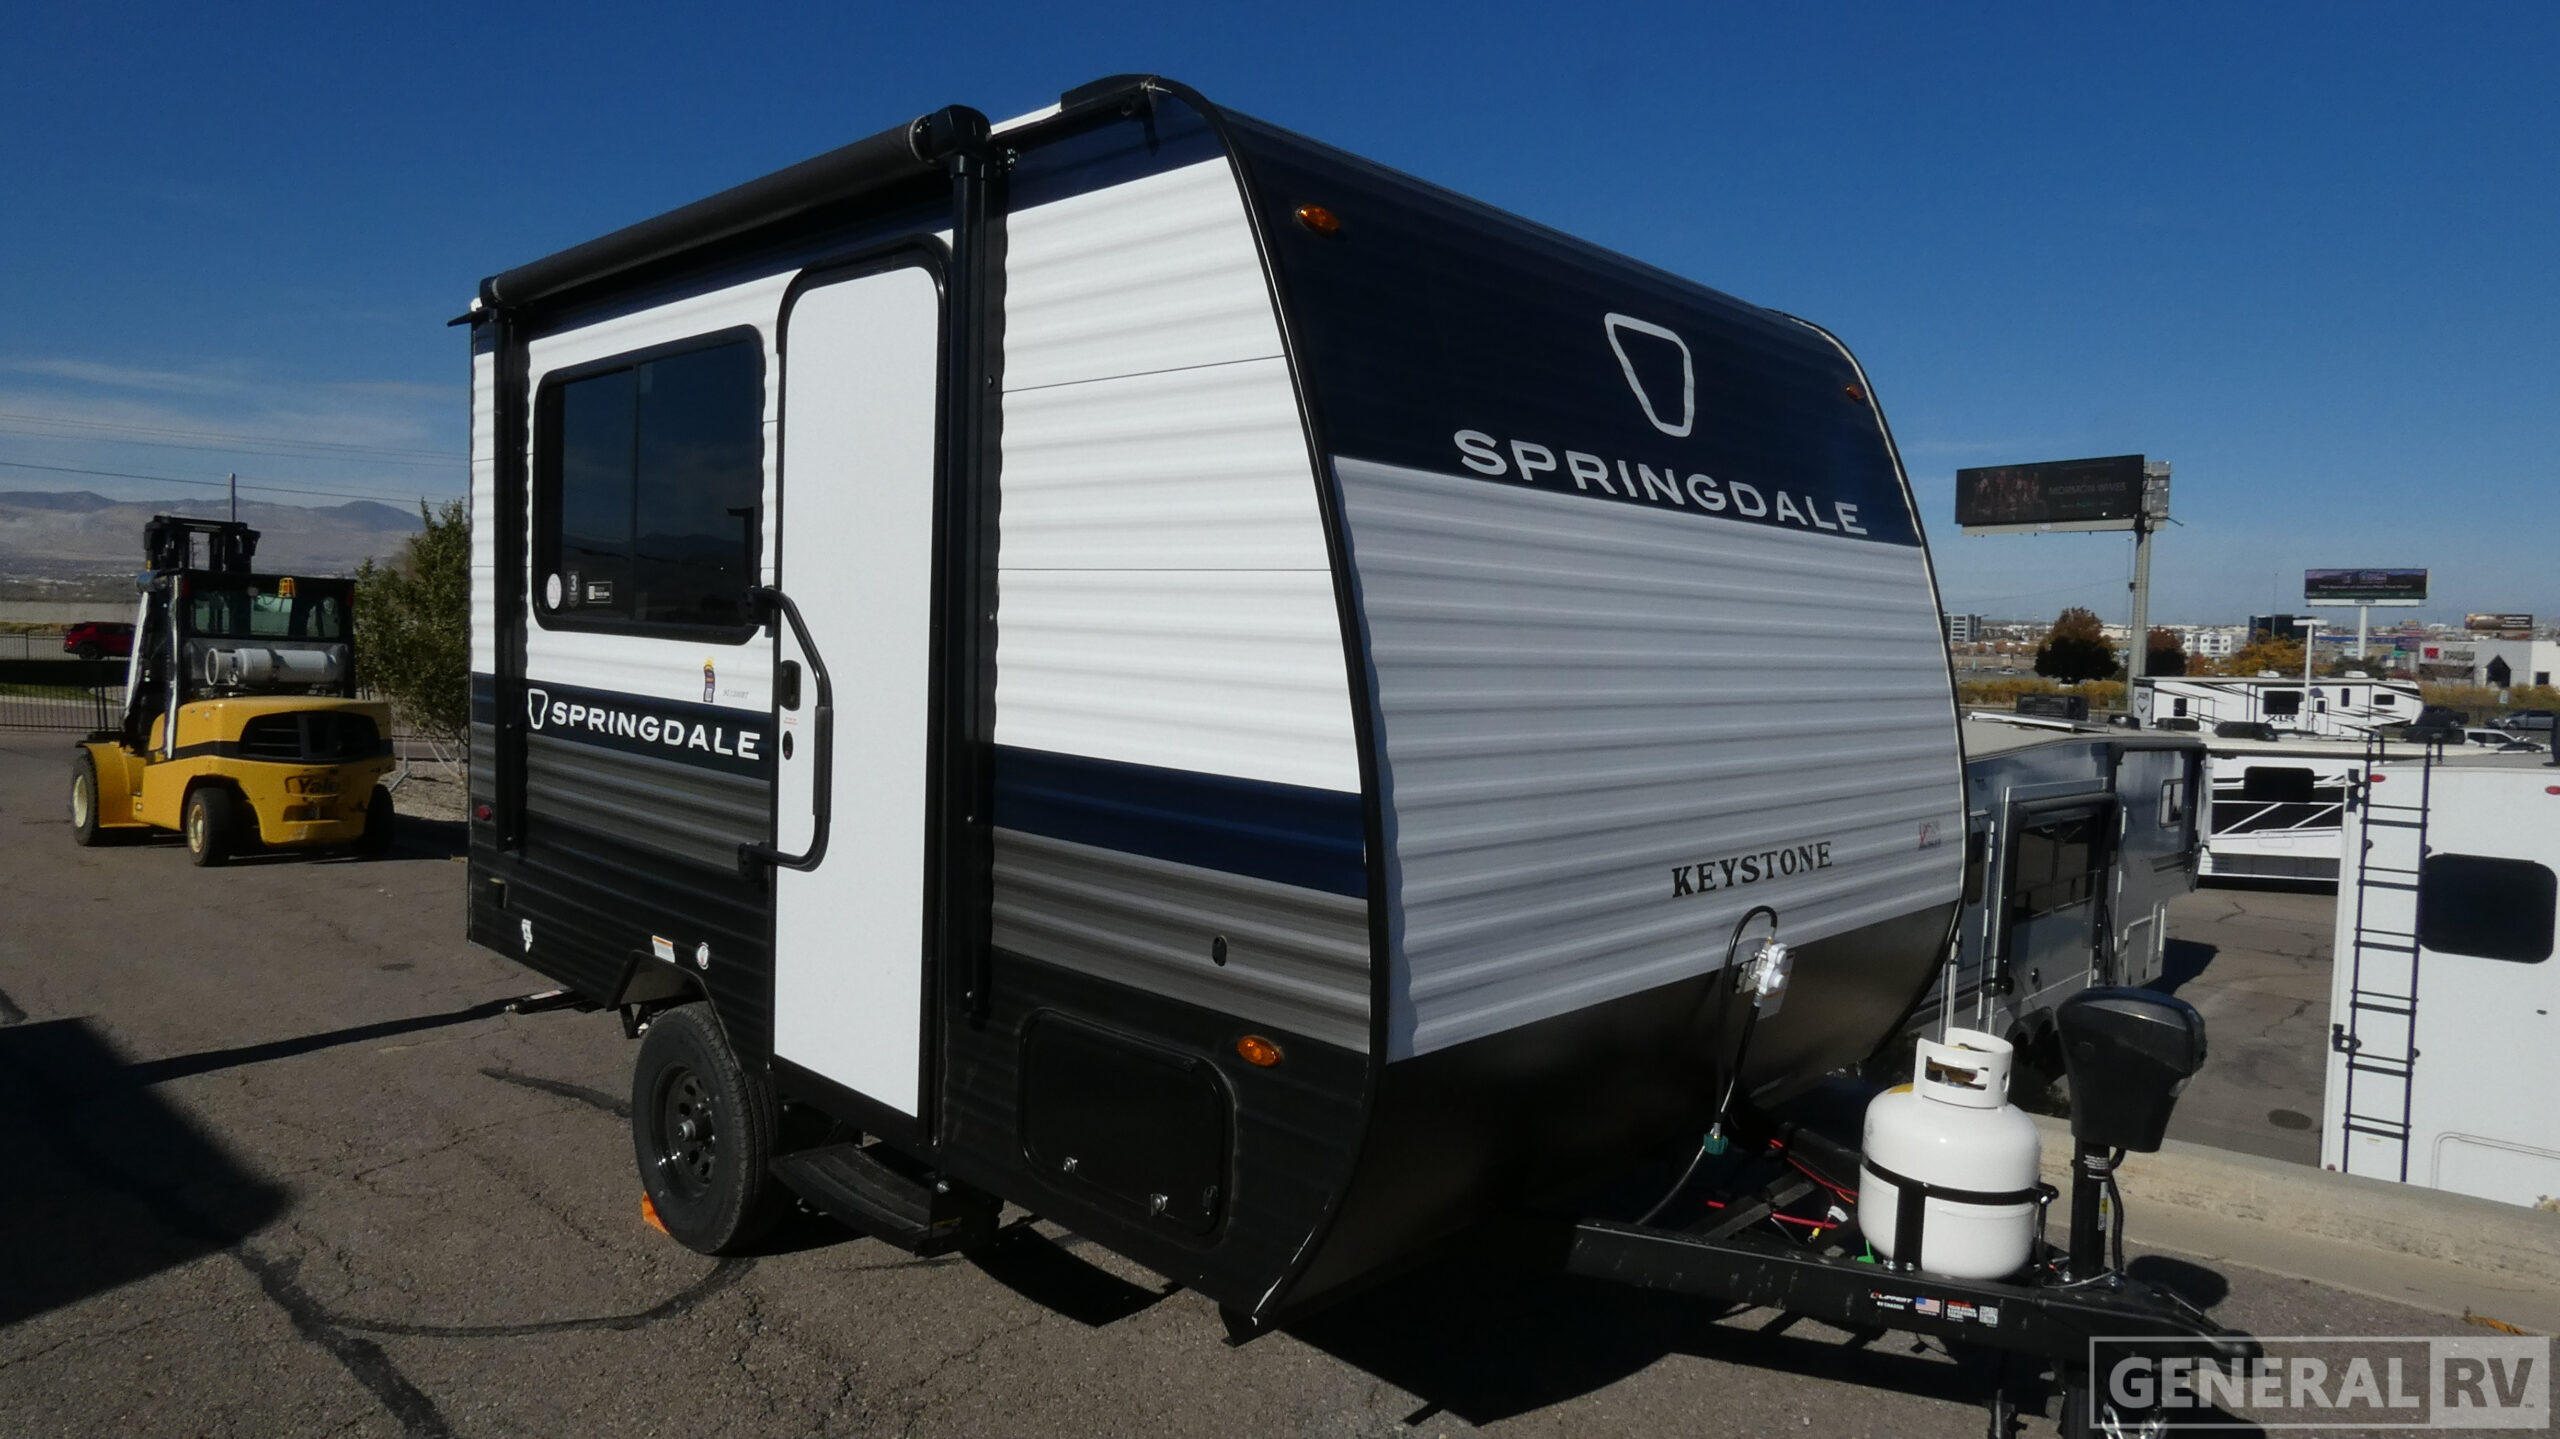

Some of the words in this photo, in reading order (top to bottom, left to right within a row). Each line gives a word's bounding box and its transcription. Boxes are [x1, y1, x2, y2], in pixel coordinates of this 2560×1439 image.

[1453, 429, 1868, 535] SPRINGDALE
[551, 701, 761, 760] SPRINGDALE
[2265, 714, 2296, 724] XLR
[1671, 841, 1833, 898] KEYSTONE
